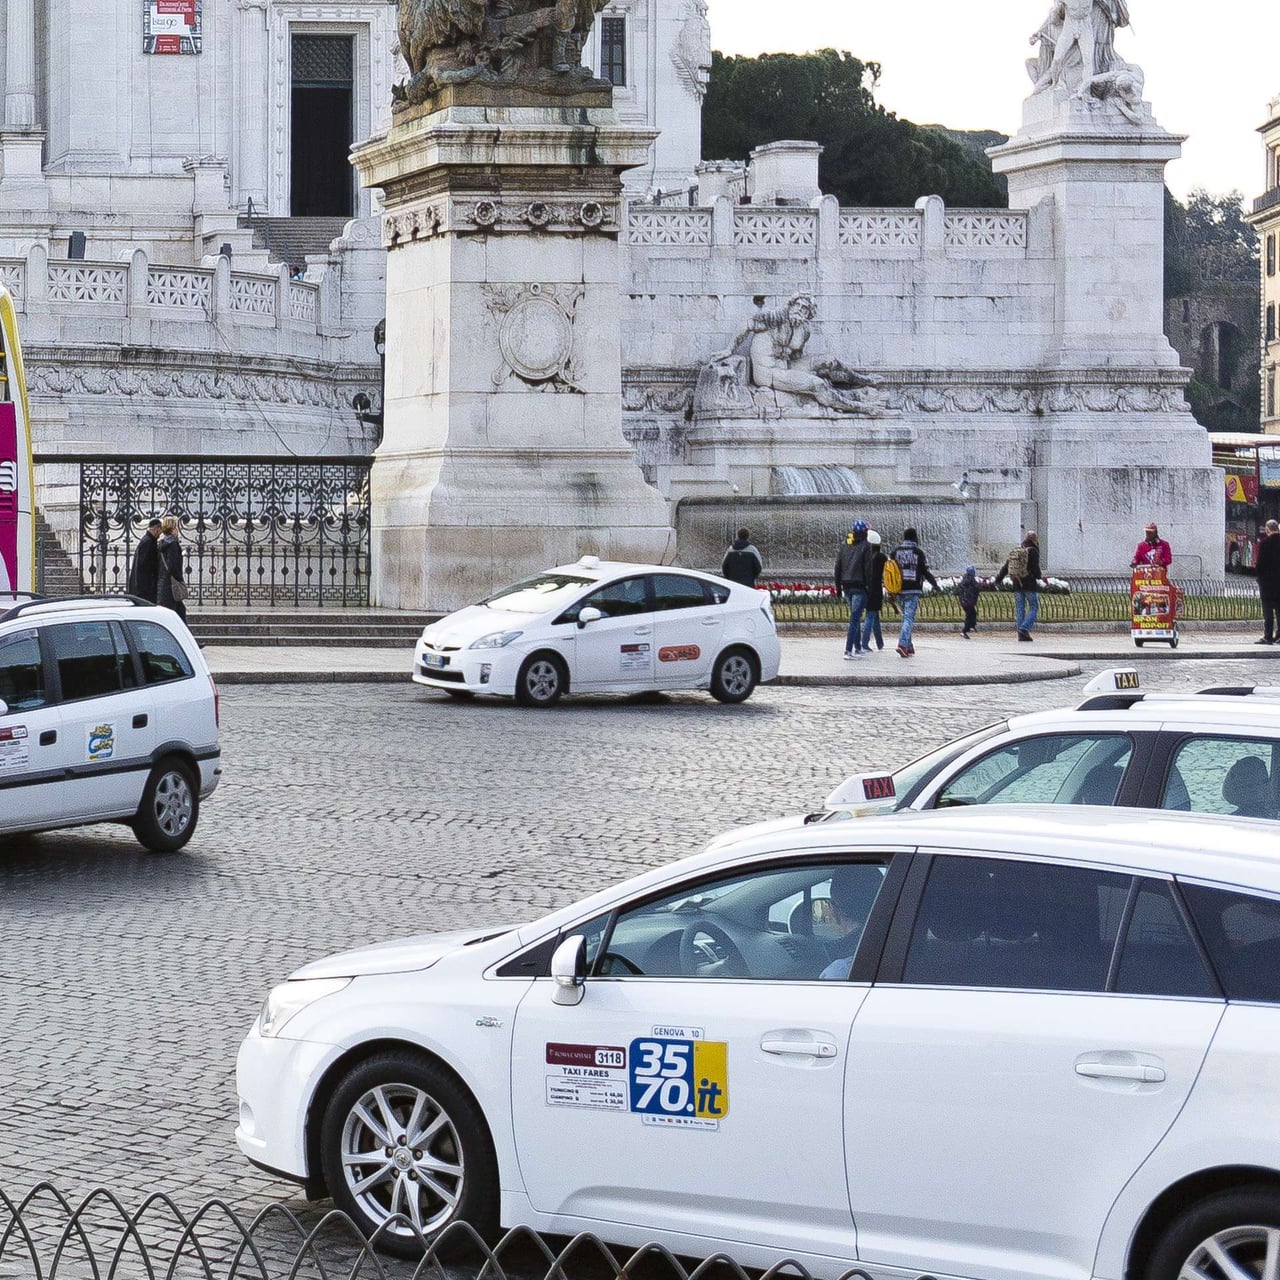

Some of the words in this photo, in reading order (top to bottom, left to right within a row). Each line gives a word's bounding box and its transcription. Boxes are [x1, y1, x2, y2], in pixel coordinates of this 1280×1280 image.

[1115, 672, 1139, 689] TAXI
[865, 776, 895, 798] TAXI
[653, 1027, 685, 1037] GENOVA
[691, 1030, 700, 1038] 10
[598, 1052, 622, 1064] 3118
[634, 1041, 690, 1078] 35
[561, 1067, 581, 1076] TAXI
[583, 1069, 609, 1078] FARES
